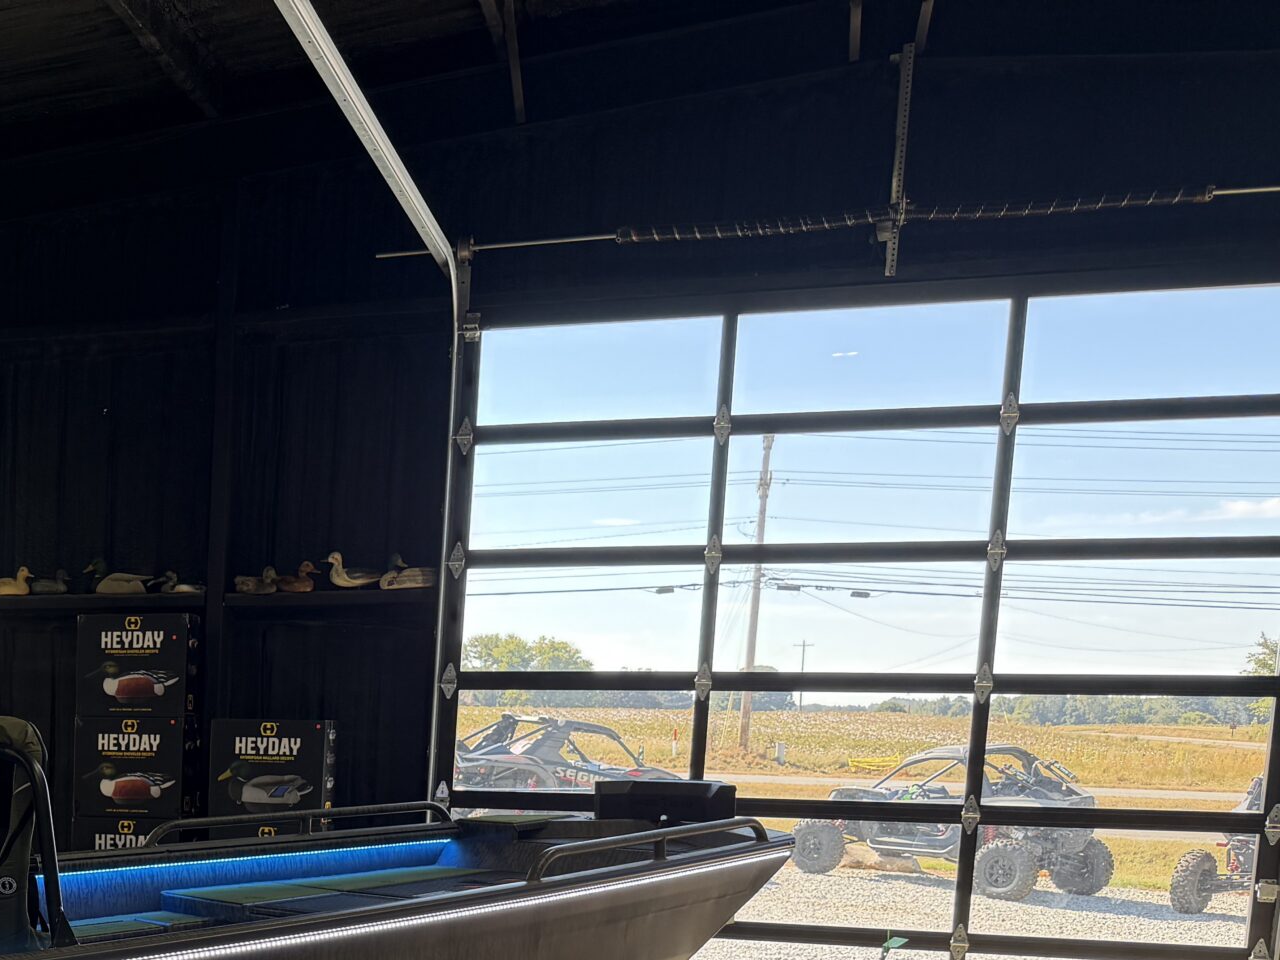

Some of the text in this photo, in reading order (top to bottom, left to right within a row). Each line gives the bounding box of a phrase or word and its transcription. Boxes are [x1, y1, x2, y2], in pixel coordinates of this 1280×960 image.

[101, 631, 164, 648] HEYDAY
[98, 733, 160, 751] HEYDAY
[235, 737, 301, 756] HEYDAY
[95, 833, 149, 850] HEYDA
